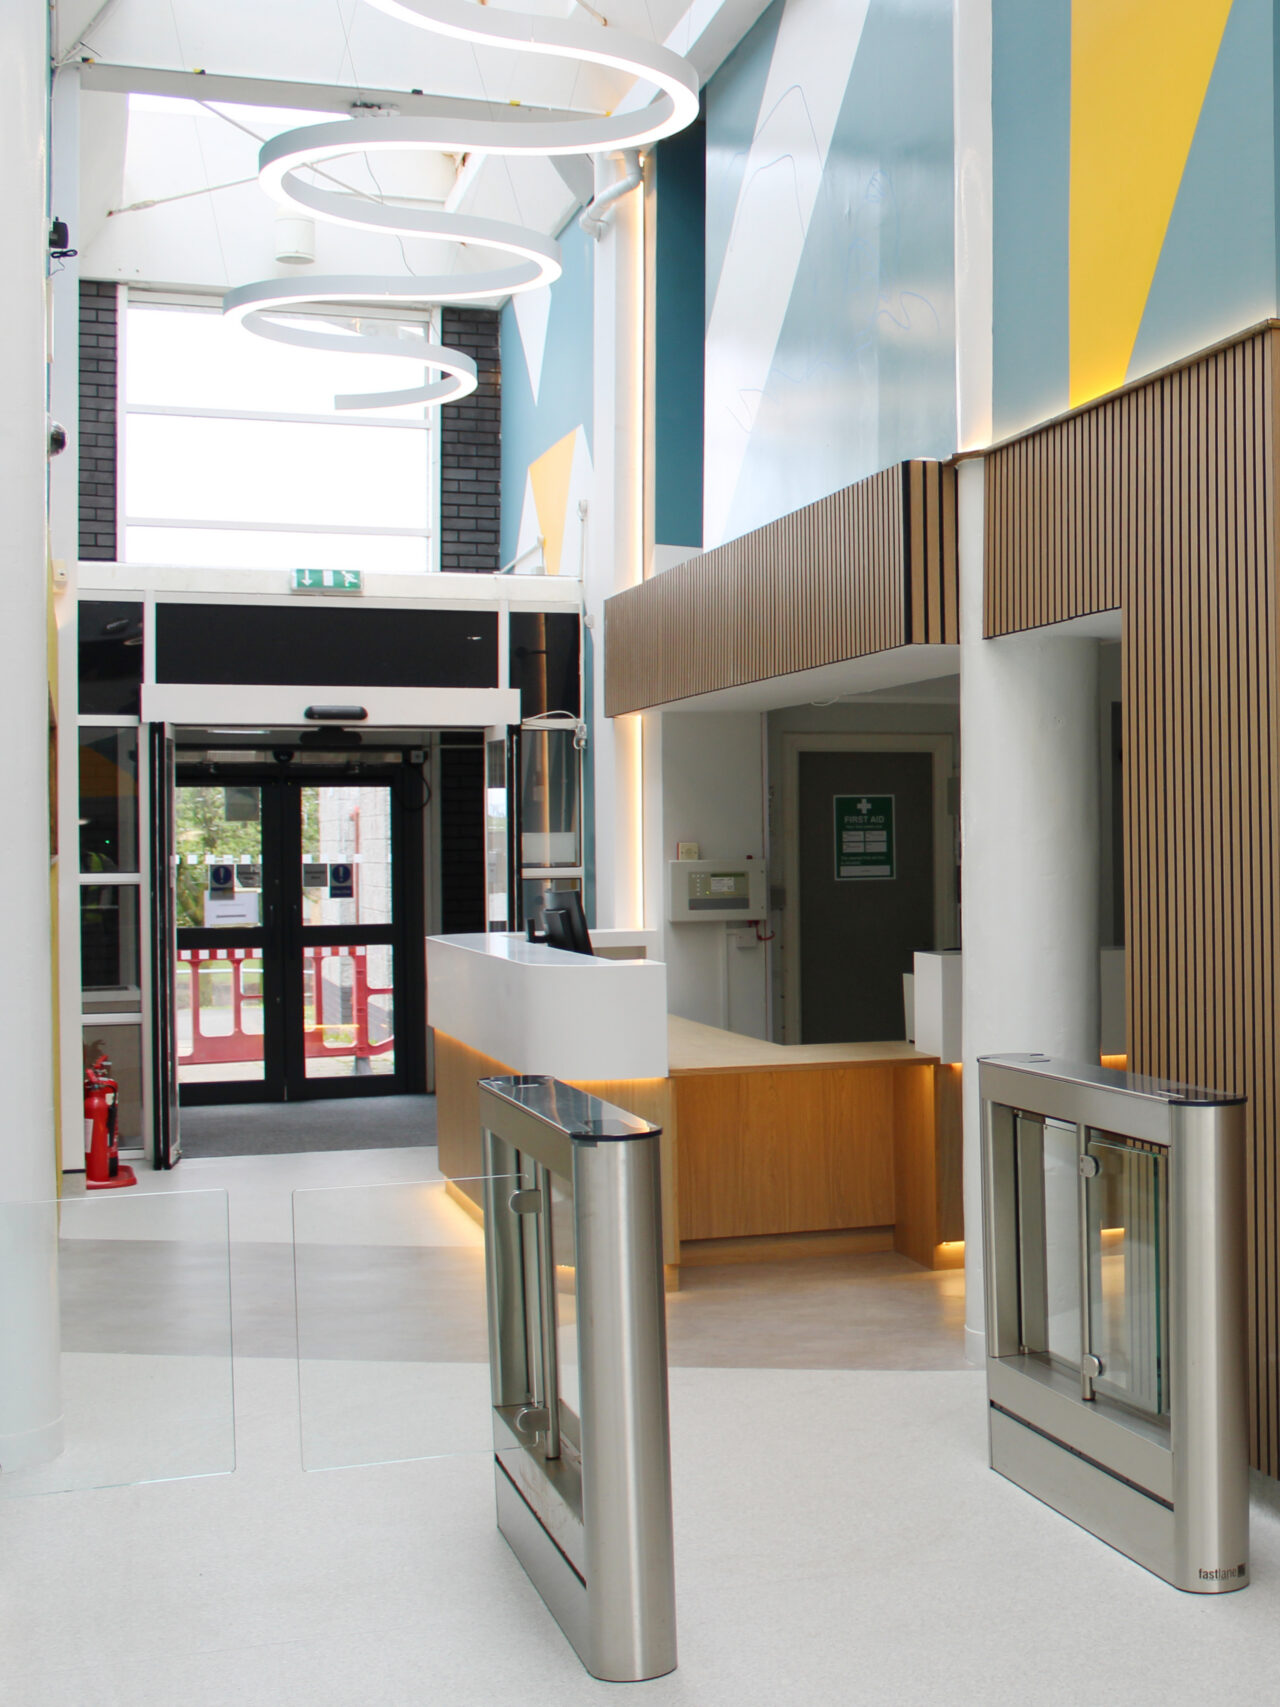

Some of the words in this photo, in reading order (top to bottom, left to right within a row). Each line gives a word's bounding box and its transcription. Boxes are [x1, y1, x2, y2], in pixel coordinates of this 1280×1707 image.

[844, 815, 868, 824] FIRST
[870, 815, 885, 823] AID
[1199, 1568, 1237, 1580] fastlane
